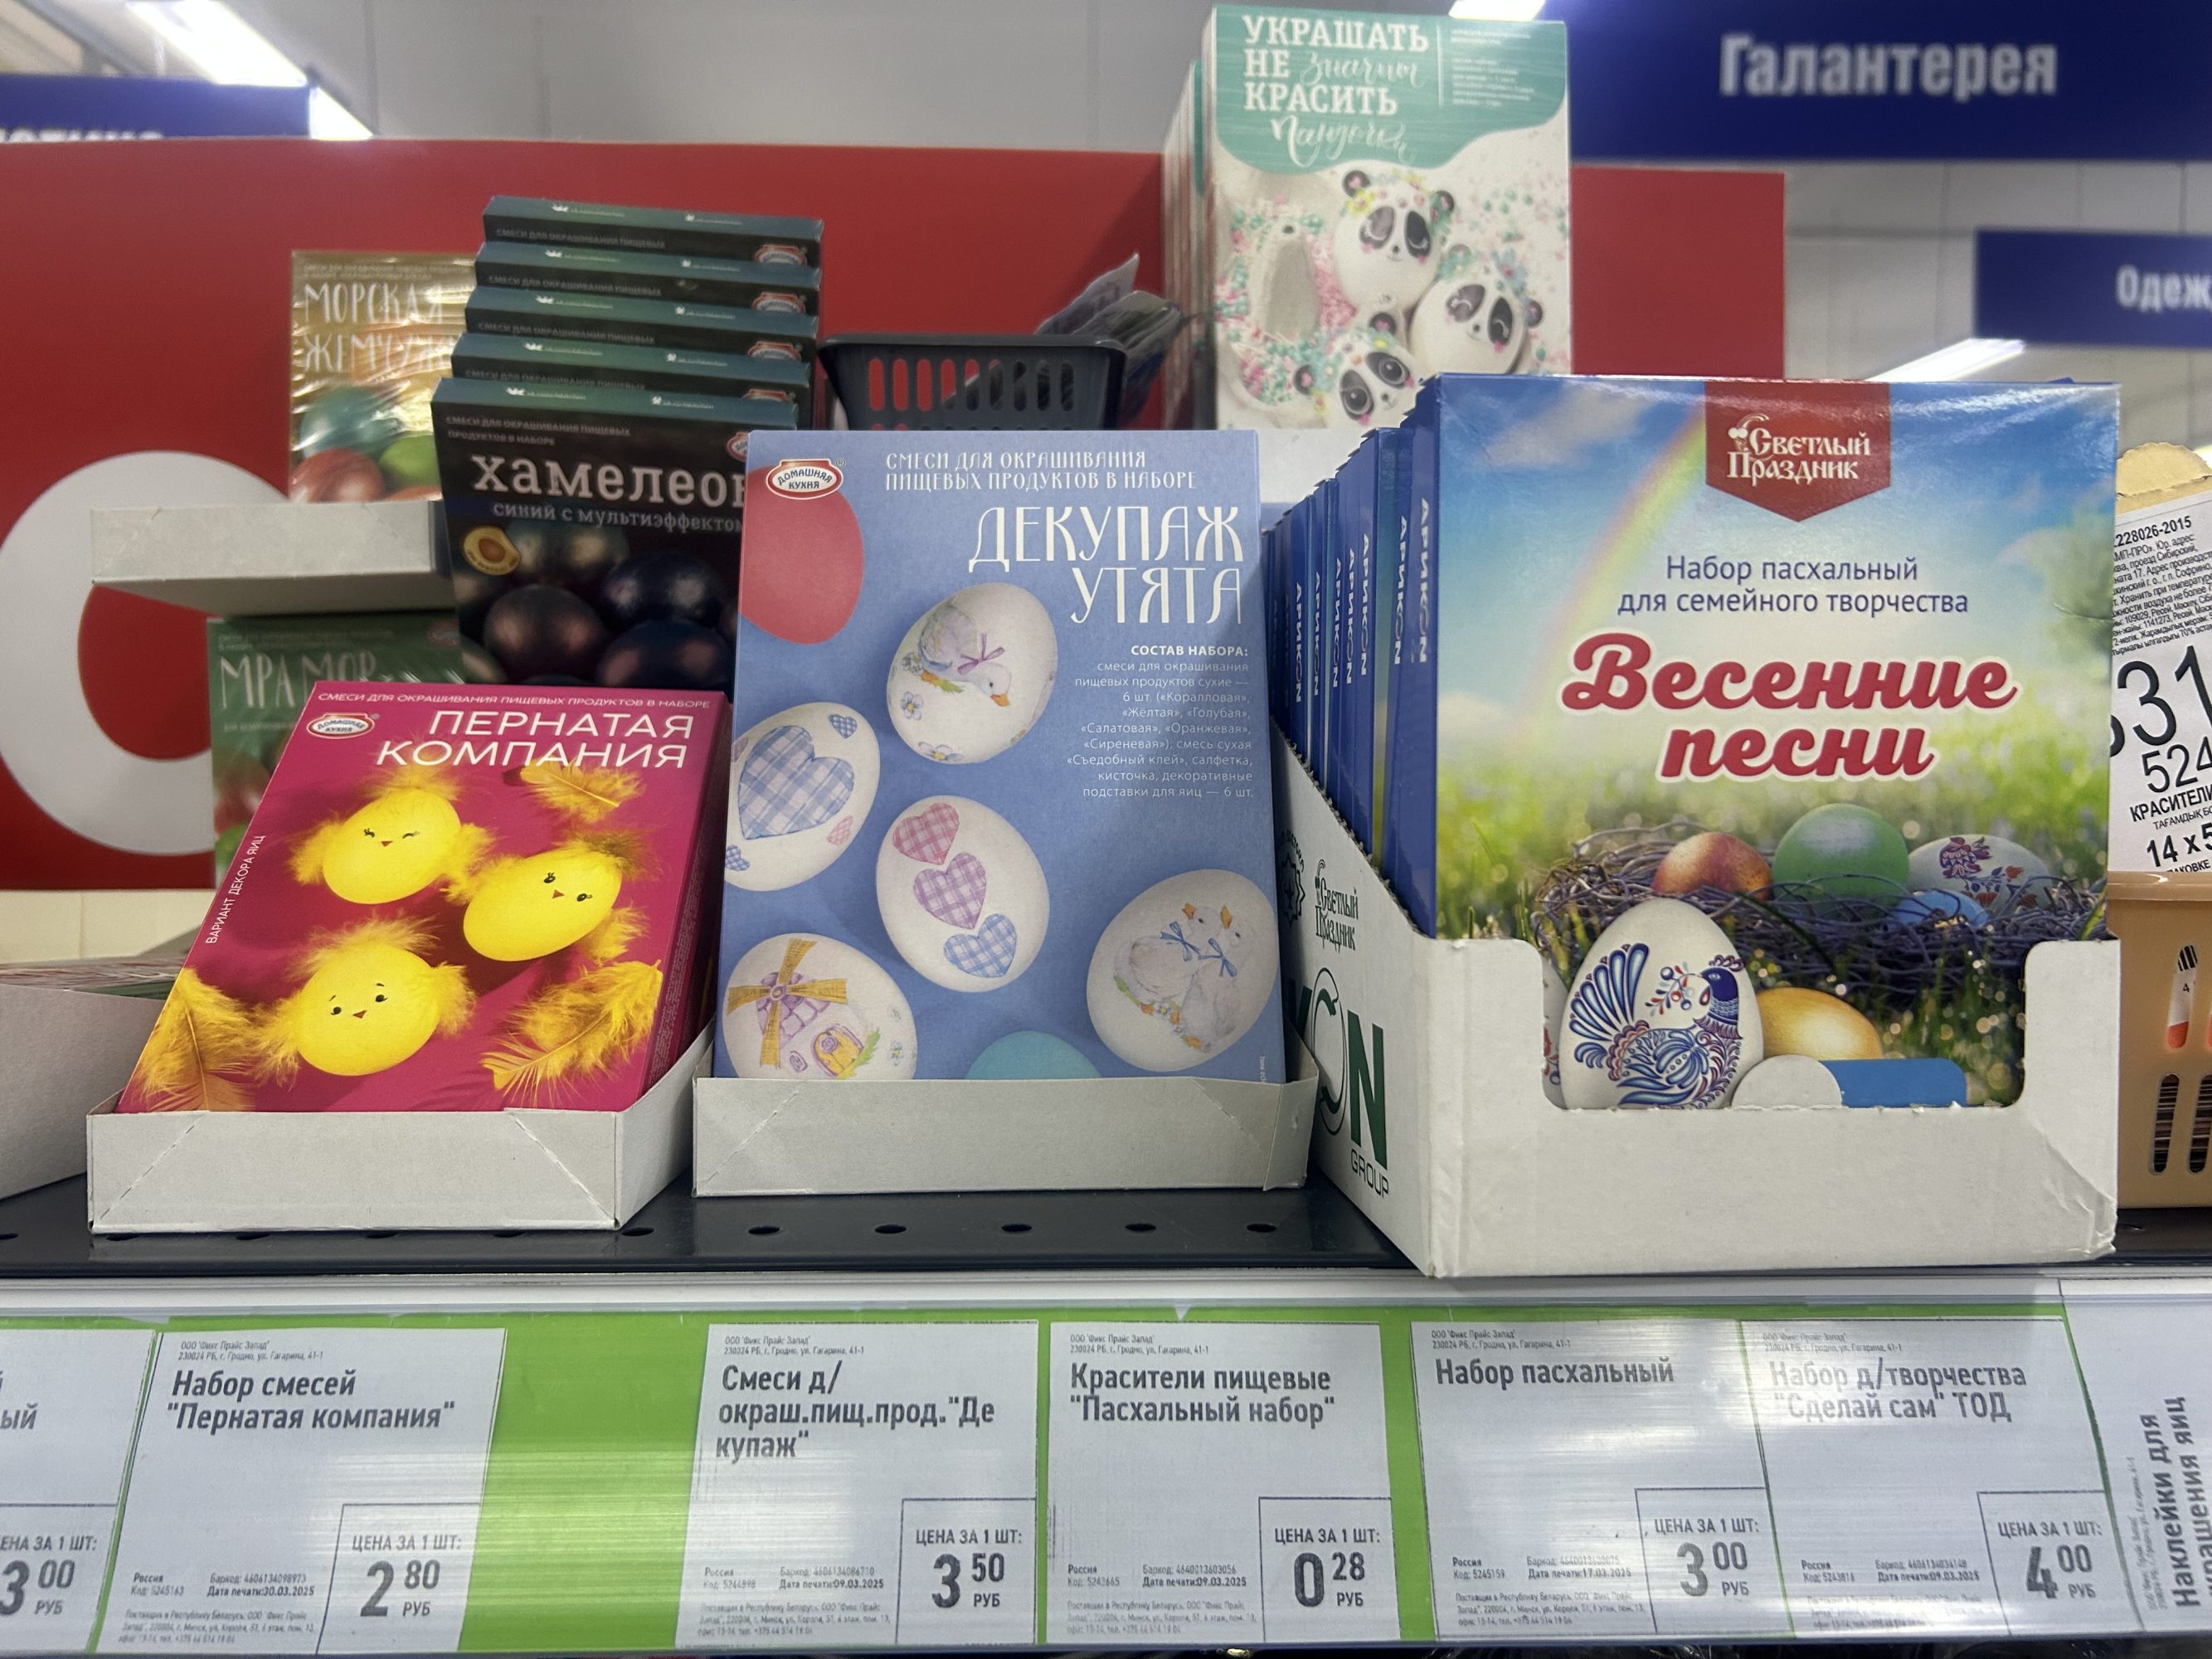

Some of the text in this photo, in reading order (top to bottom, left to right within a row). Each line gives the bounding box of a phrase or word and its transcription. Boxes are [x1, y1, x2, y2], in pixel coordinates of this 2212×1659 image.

[1242, 15, 1430, 52] УКРАШАТЬ
[1244, 49, 1290, 77] НЕ
[1719, 32, 2059, 102] Галантерея
[1244, 81, 1398, 115] КРАСИТЬ
[2116, 265, 2212, 314] Одеж
[886, 451, 1146, 471] СМЕСИ ДЛЯ ОКРАШИВАНИЯ
[777, 468, 833, 486] ДОМАШНЯЯ
[789, 480, 819, 489] КУХНЯ
[886, 471, 1197, 493] ПИЩЕВЫХ ПРОДУКТОВ В НАБОРЕ
[493, 503, 556, 519] синий
[562, 508, 573, 519] с
[968, 505, 1244, 573] ДЕКУПАЖ
[1666, 556, 1918, 584] Набор пасхальный
[1070, 567, 1242, 624] УТЯТА
[1617, 588, 1968, 617] для семейного творчества
[1130, 645, 1248, 657] СОСТАВ НАБОРА:
[1097, 663, 1248, 674] смеси для окрашивания
[1561, 632, 2017, 710] Весенние
[1075, 678, 1232, 689] пищевых продуктов сухие
[1123, 692, 1250, 703] 6 шт. («Коралловая»,
[318, 693, 365, 702] СМЕСИ
[367, 694, 395, 703] ДЛЯ
[397, 694, 498, 703] ОКРАШИВАНИЯ
[501, 696, 565, 705] ПИЩЕВЫХ
[568, 698, 644, 707] ПРОДУКТОВ
[659, 700, 711, 709] НАБОРЕ
[1187, 708, 1251, 720] «Голубая»,
[429, 711, 693, 739] ПЕРНАТАЯ
[1081, 723, 1252, 735] «Салатовая», «Оранжевая»,
[377, 740, 687, 768] КОМПАНИЯ
[1083, 738, 1252, 752] «Сиреневая»), смесь сухая
[1660, 727, 1935, 778] песни
[1067, 754, 1252, 766] «Съедобный клей», салфетка,
[1098, 771, 1253, 782] кисточка, декоративные
[1083, 787, 1253, 799] подставки для яиц 6 шт.
[2146, 834, 2179, 868] 14
[206, 835, 266, 944] ВАРИАНТ ДЕКОРА ЯИЦ
[1351, 1148, 1390, 1199] GROUP
[172, 1370, 357, 1402] Набор смесей
[722, 1360, 843, 1394] Смеси д/
[1071, 1362, 1331, 1394] Красители пищевые
[1436, 1356, 1675, 1390] Набор пасхальный
[1769, 1356, 2027, 1399] Набор д/творчества
[167, 1400, 455, 1435] "Пернатая компания"
[1071, 1394, 1334, 1428] "Пасхальный набор"
[1774, 1391, 2012, 1424] "Сделай сам" ТОД
[2164, 1396, 2194, 1444] яиц
[716, 1430, 809, 1464] купаж"
[2140, 1413, 2172, 1463] для
[916, 1529, 1022, 1546] ЦЕНА ЗА 1 ШТ:
[1275, 1528, 1381, 1545] ЦЕНА ЗА 1 ШТ:
[1654, 1518, 1759, 1535] ЦЕНА ЗА 1 ШТ:
[2153, 1471, 2200, 1607] Наклейки
[931, 1553, 1004, 1608] 3 50
[1067, 1564, 1097, 1574] Россия
[1142, 1578, 1163, 1588] Дата
[1294, 1551, 1365, 1608] 0 28
[1676, 1541, 1748, 1597] 3 00
[2025, 1544, 2093, 1599] 4 00
[359, 1559, 440, 1618] 2 80
[974, 1593, 1000, 1608] РУБ
[1337, 1592, 1364, 1607] РУБ
[1722, 1582, 1749, 1596] РУБ
[2068, 1584, 2096, 1598] РУБ
[402, 1601, 431, 1617] РУБ
